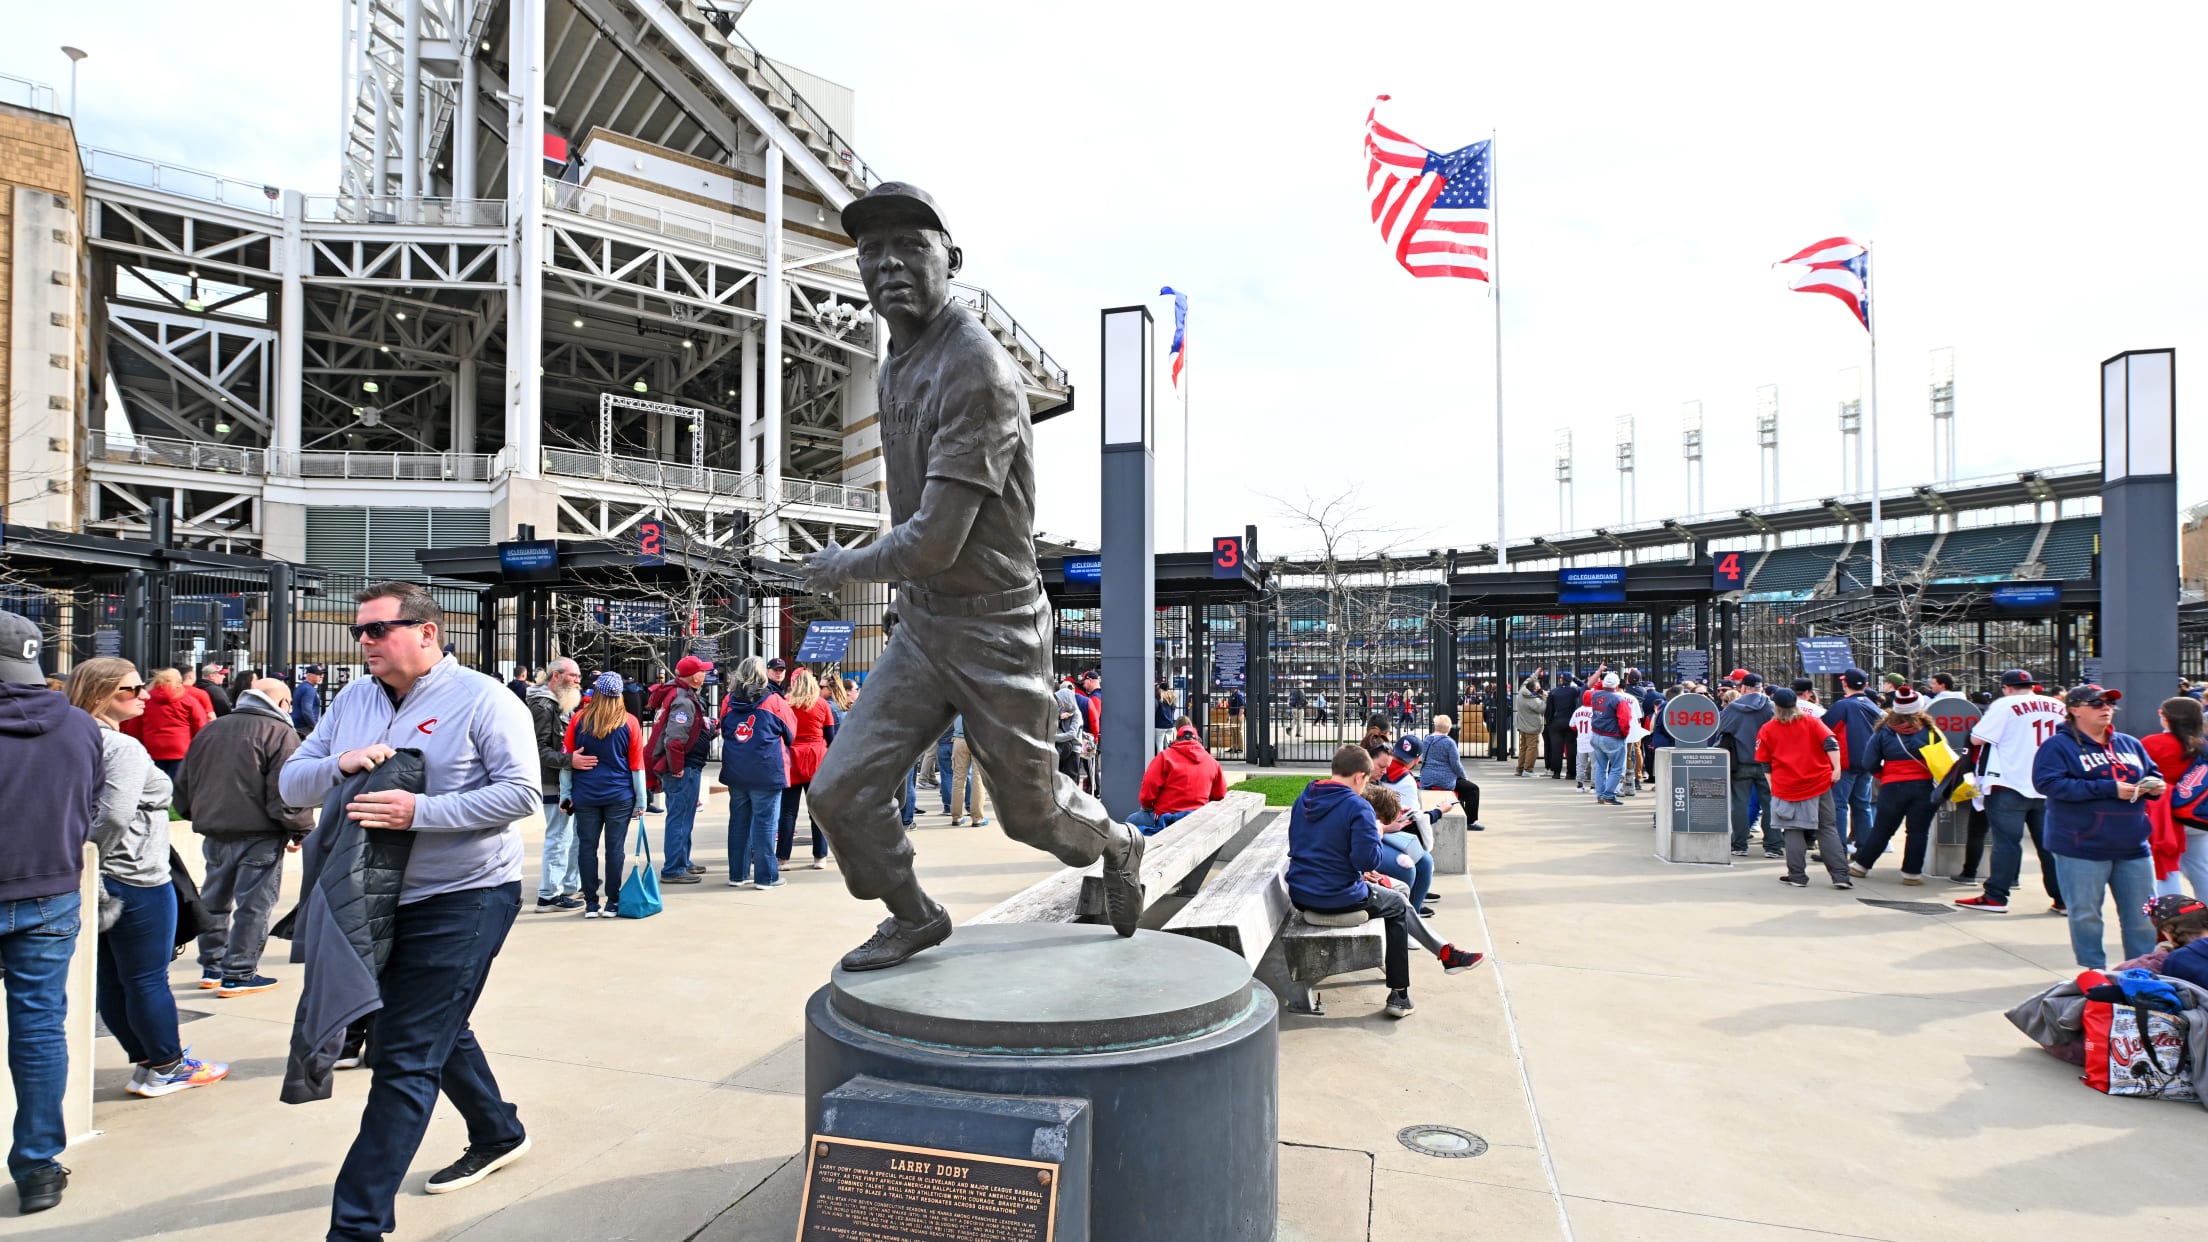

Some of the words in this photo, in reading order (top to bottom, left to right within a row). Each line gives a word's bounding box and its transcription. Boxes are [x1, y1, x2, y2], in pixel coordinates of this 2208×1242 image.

[641, 524, 660, 554] 2
[1217, 539, 1238, 568] 3
[1567, 573, 1618, 581] @CLEGUARDIANS
[1718, 553, 1741, 580] 4
[22, 640, 38, 659] C
[1579, 720, 1589, 733] 11
[1668, 710, 1715, 726] 1948
[2032, 719, 2055, 746] 11
[1675, 787, 1685, 812] 1948
[890, 1159, 931, 1174] LARRY
[937, 1165, 969, 1179] DOBY
[837, 1179, 864, 1187] COMBINED
[917, 1190, 952, 1199] ATHLETICISM
[998, 1201, 1024, 1209] BRAVERY
[880, 1178, 931, 1190] AFRICAN-AMERICAN
[932, 1185, 967, 1194] BALLPLAYER
[988, 1193, 1017, 1201] AMERICAN
[924, 1178, 955, 1186] CLEVELAND
[991, 1186, 1012, 1194] LEAGUE
[1014, 1189, 1043, 1198] BASEBALL
[920, 1197, 952, 1206] RESONATES
[954, 1201, 976, 1209] ACROSS
[978, 1205, 1018, 1215] GENERATIONS.
